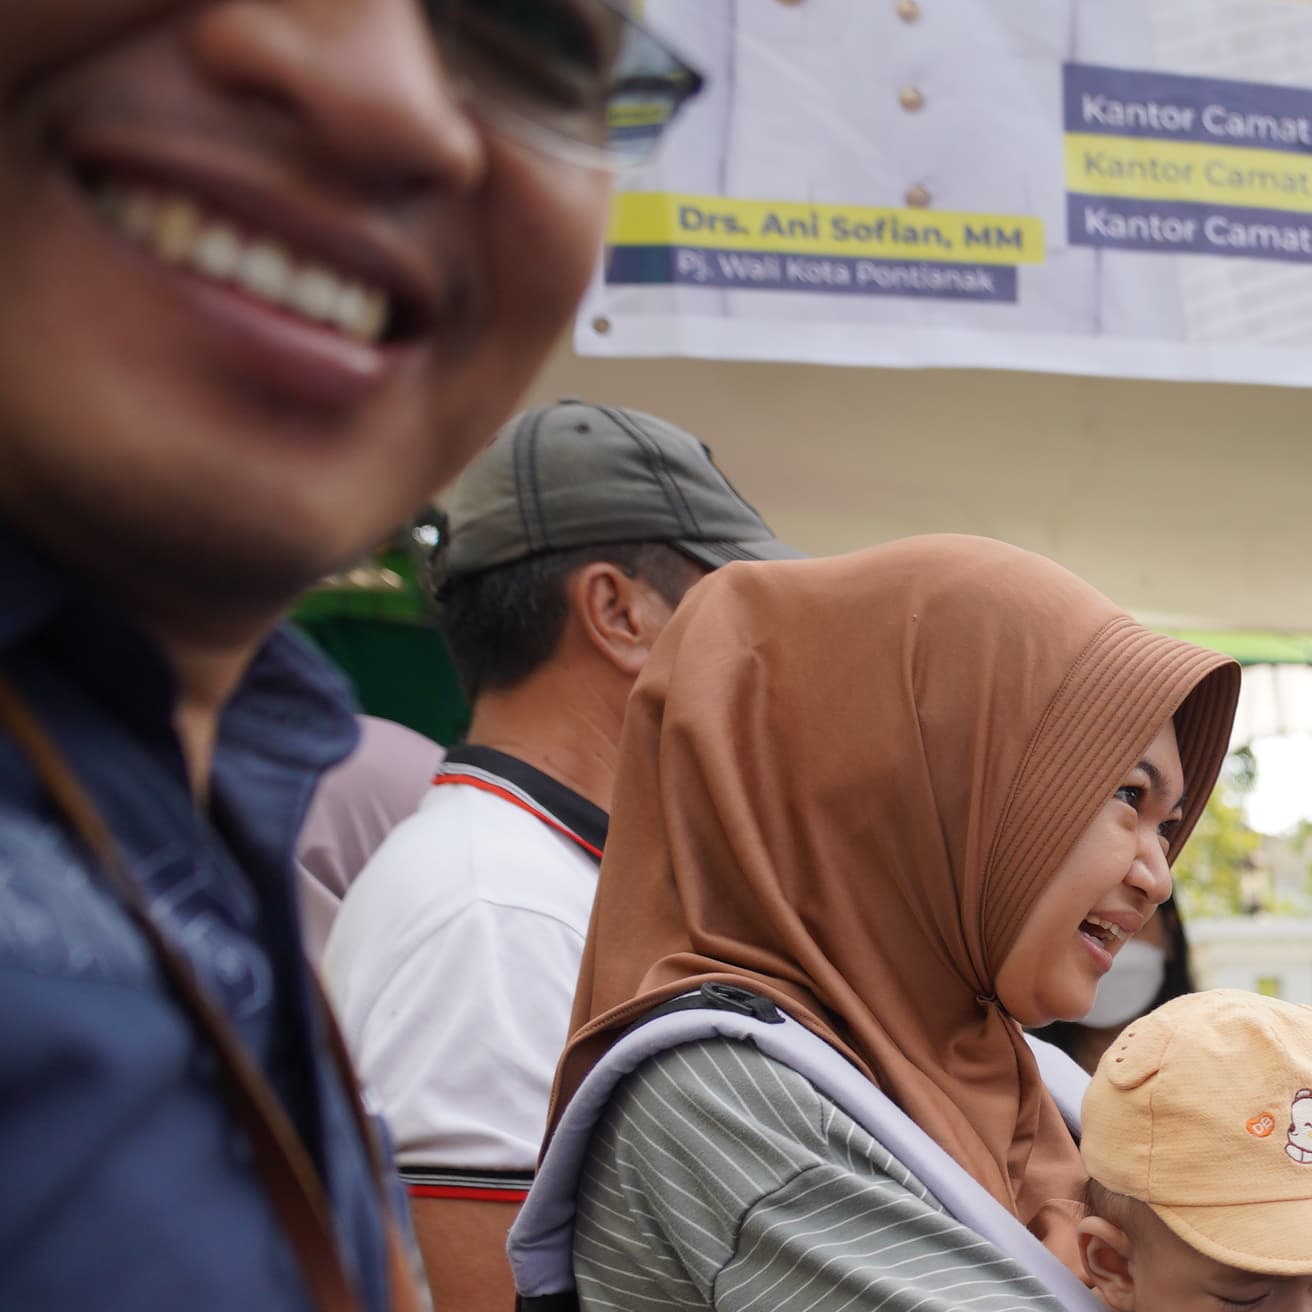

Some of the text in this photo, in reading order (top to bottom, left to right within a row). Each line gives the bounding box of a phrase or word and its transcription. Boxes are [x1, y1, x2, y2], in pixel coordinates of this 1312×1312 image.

[1082, 93, 1195, 132] Kantor
[1201, 104, 1312, 145] Camat
[1083, 150, 1194, 184] Kantor
[1204, 159, 1312, 196] Camat
[677, 206, 1024, 252] Drs. Ani Sofian, MM
[1084, 206, 1196, 243] Kantor
[717, 252, 781, 283] Wali
[787, 257, 851, 287] Kota
[855, 259, 997, 294] Pontianak
